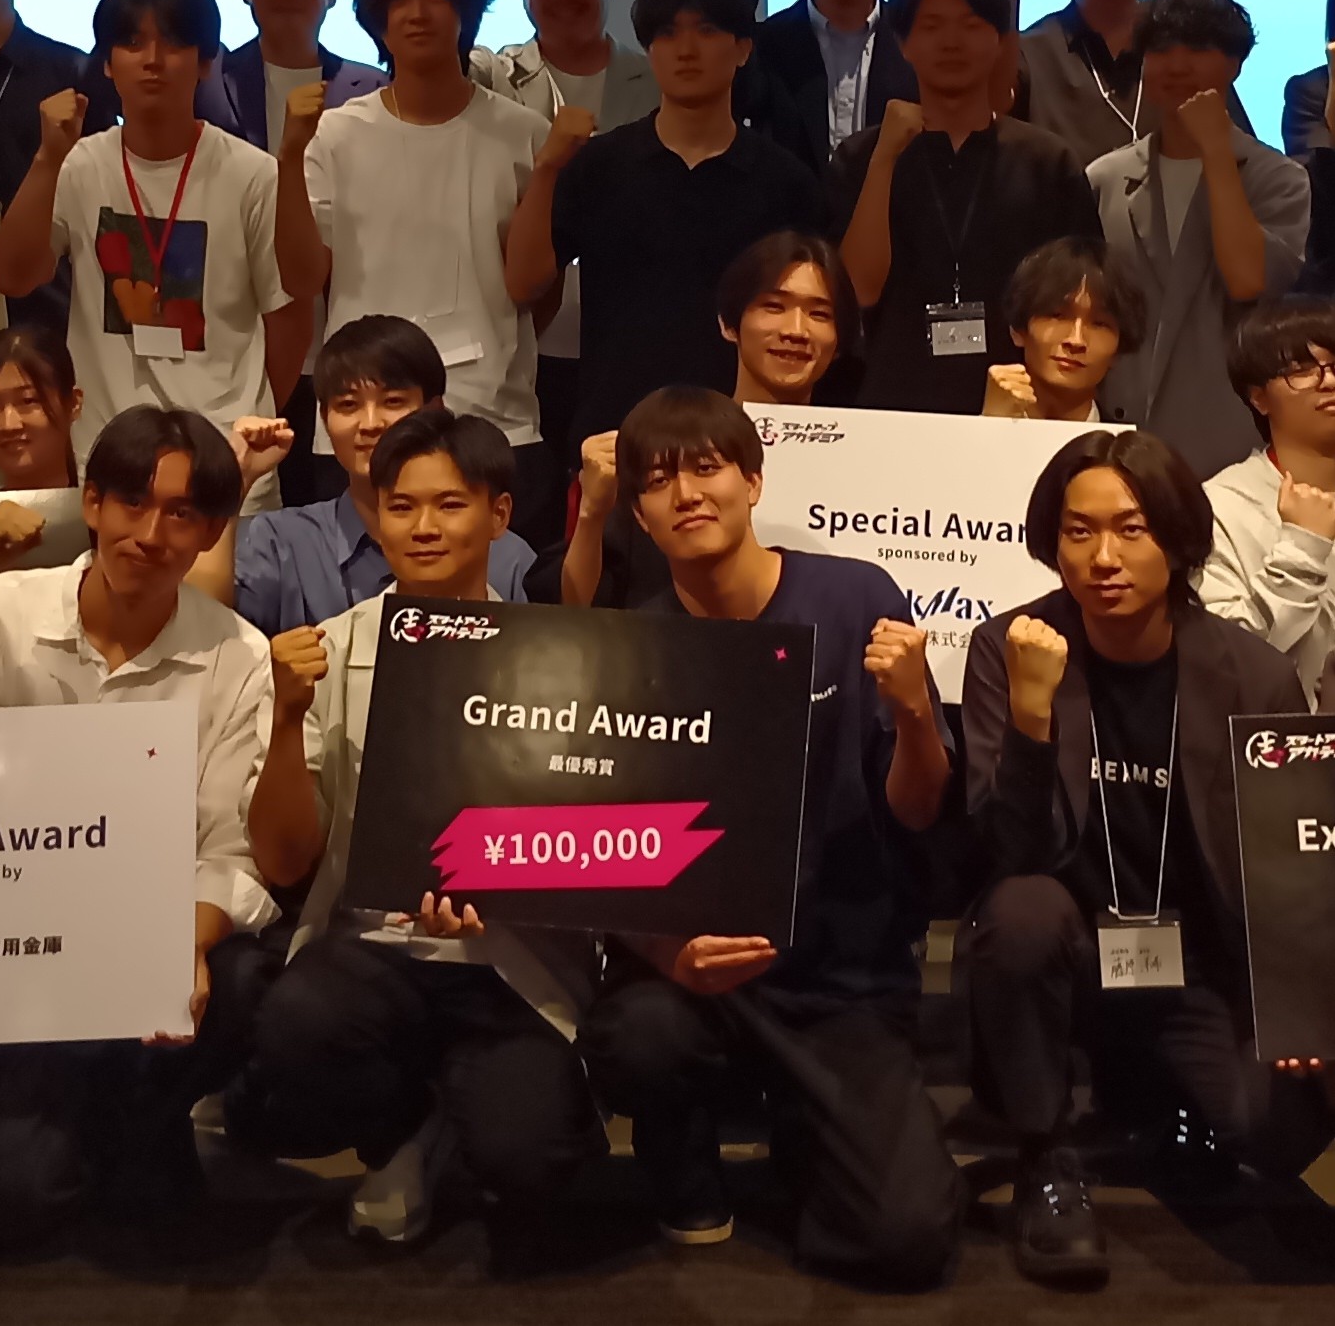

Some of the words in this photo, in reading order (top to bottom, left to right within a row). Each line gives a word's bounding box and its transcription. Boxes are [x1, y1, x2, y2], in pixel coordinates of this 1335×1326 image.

[808, 503, 931, 538] Special
[942, 513, 1027, 544] Awar
[877, 547, 955, 563] sponsored
[960, 550, 977, 566] by
[906, 586, 994, 621] kMax
[463, 695, 578, 733] Grand
[588, 705, 711, 744] Award
[549, 754, 614, 776] 最優秀賞
[484, 827, 662, 869] ¥100,000
[2, 864, 22, 882] by
